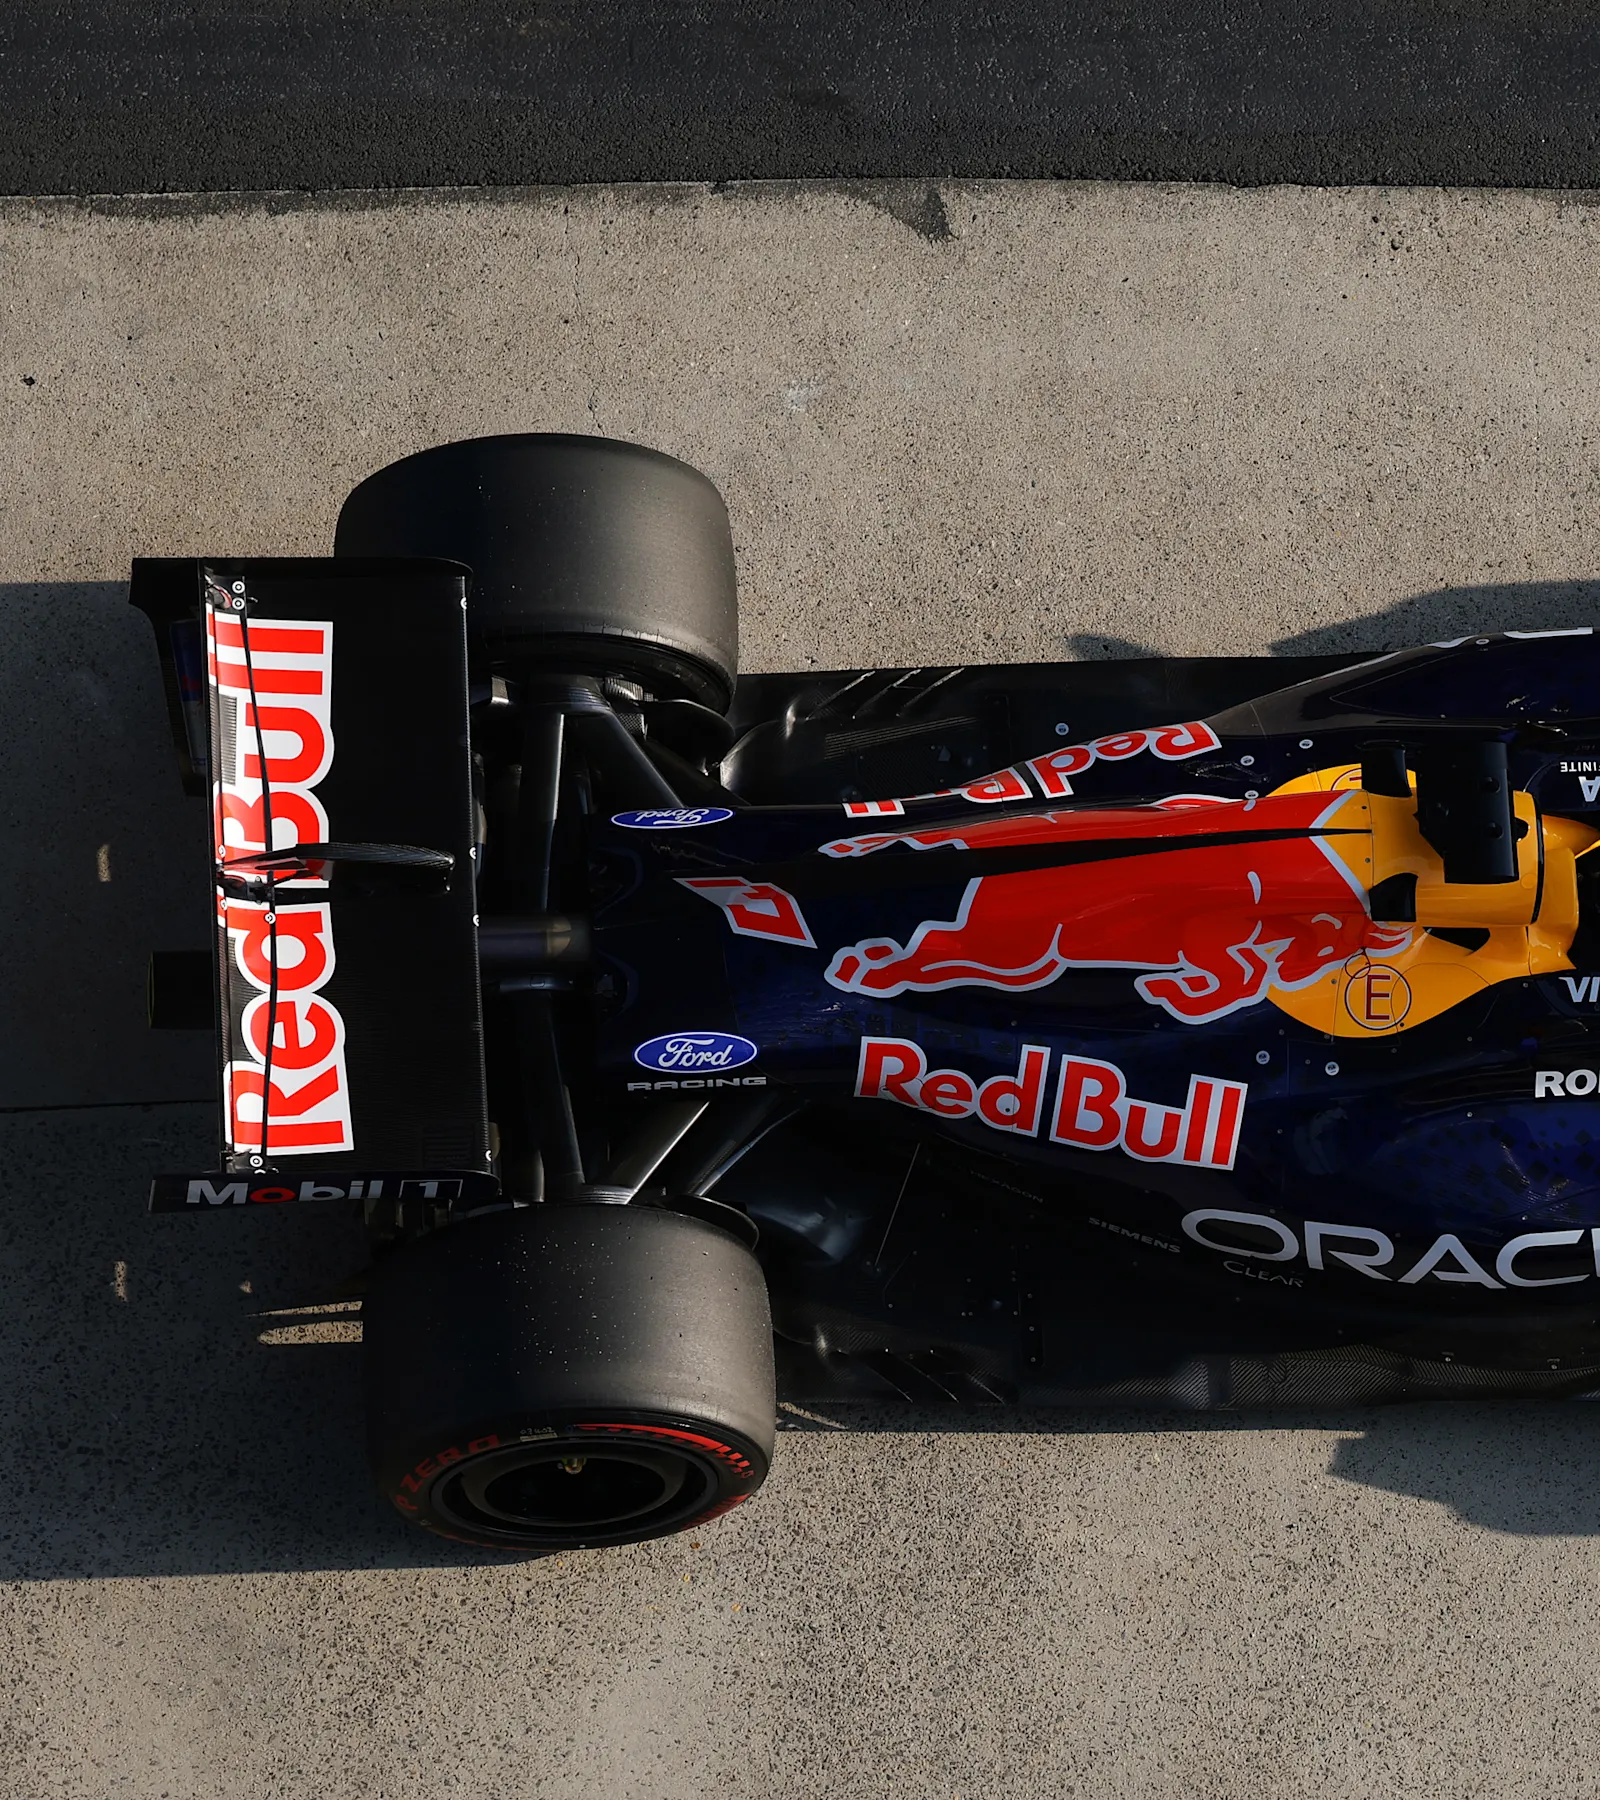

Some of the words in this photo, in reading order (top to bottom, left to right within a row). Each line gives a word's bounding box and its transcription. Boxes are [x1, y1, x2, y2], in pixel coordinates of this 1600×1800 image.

[206, 612, 333, 887] Bull
[1028, 720, 1223, 799] Red
[634, 807, 711, 825] Ford
[1366, 975, 1390, 1020] E
[216, 900, 352, 1152] Red
[655, 1037, 742, 1068] Ford
[627, 1076, 767, 1091] RACING
[853, 1036, 1051, 1138] Red
[1049, 1053, 1248, 1171] Bull
[186, 1180, 383, 1205] Mobil
[1087, 1215, 1181, 1254] SIEMENS
[1222, 1259, 1305, 1288] CLEAR
[400, 1434, 500, 1491] ZERO
